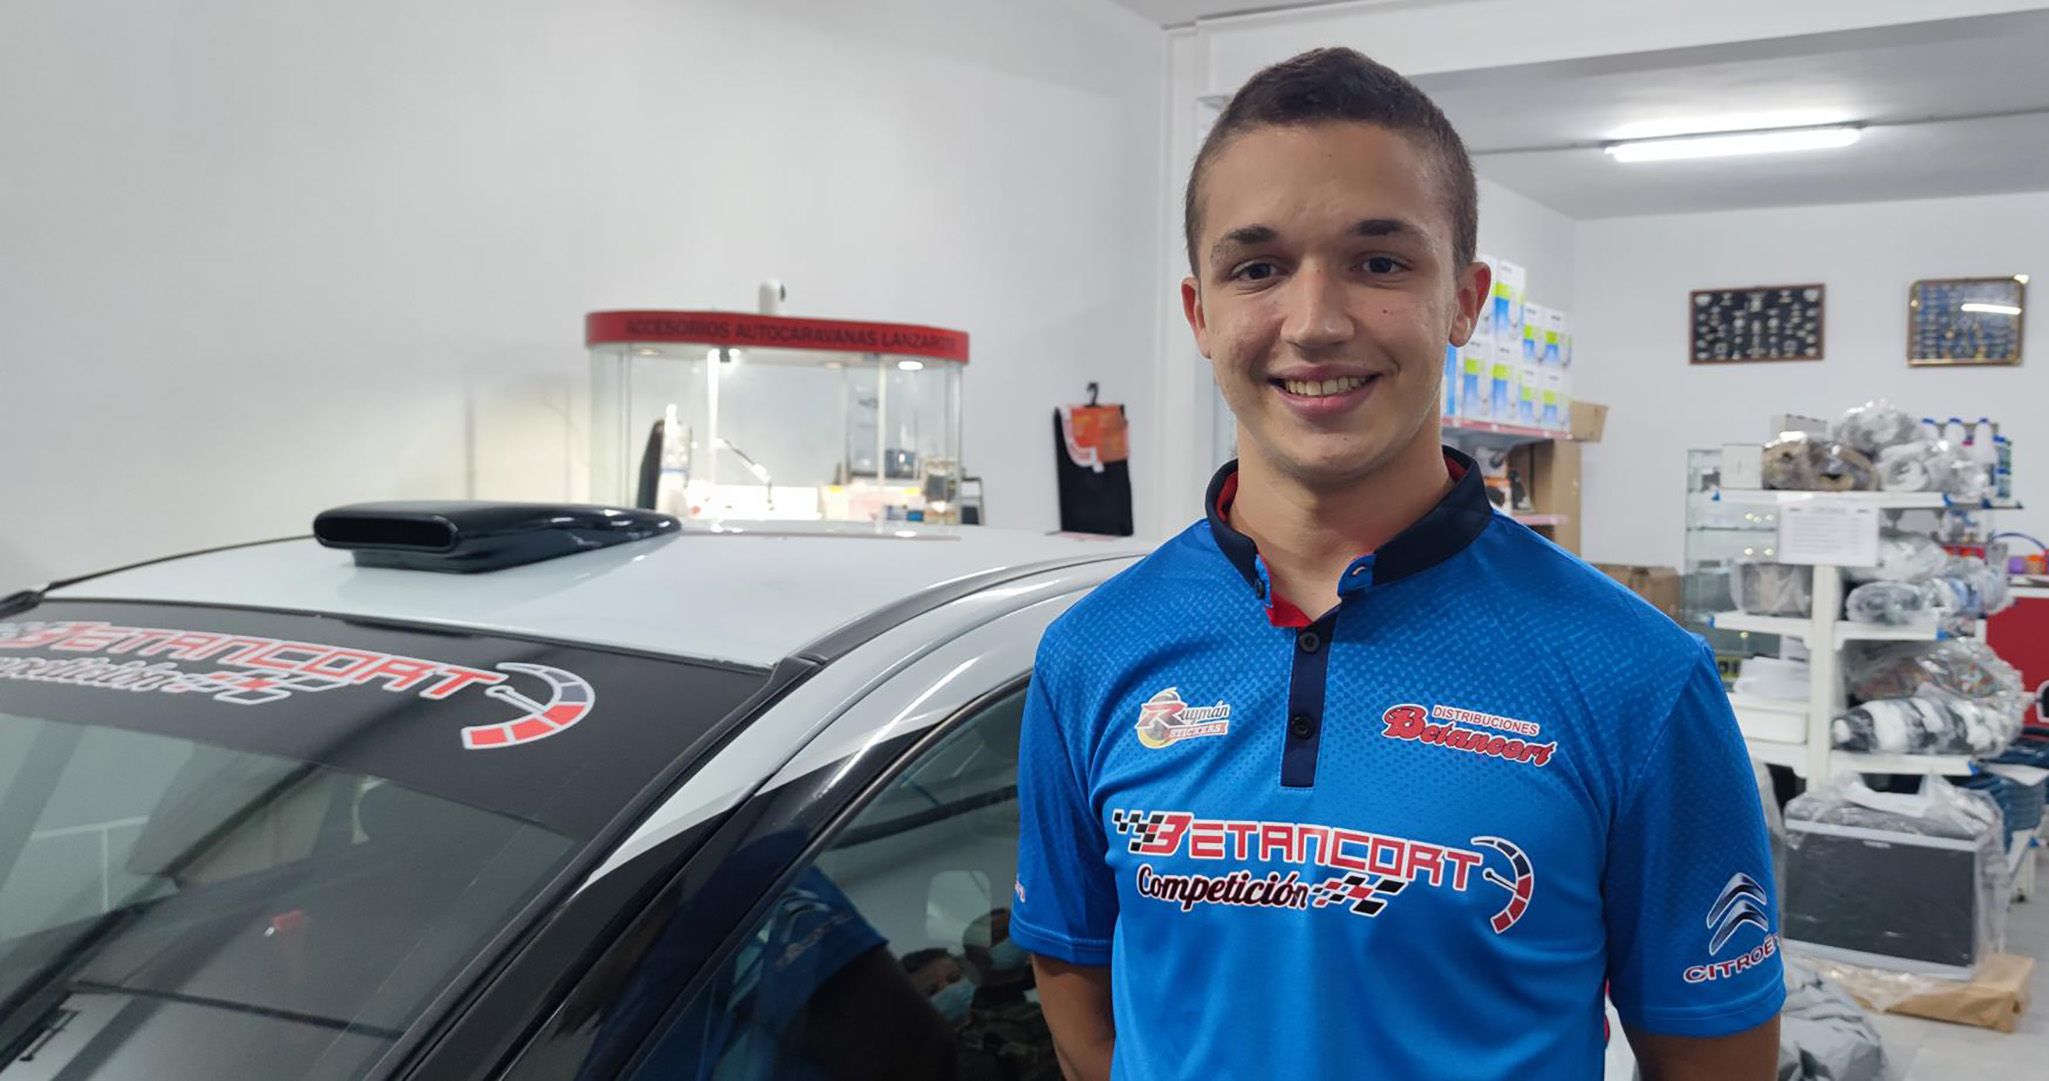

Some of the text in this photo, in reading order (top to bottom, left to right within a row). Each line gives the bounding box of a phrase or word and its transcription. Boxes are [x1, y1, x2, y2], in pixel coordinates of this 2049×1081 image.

[624, 318, 730, 339] ACCESORIOS
[735, 324, 877, 347] AUTOCARAVANAS
[1382, 703, 1557, 766] Betancort
[1431, 704, 1541, 736] DISTRIBUCIONES
[1131, 811, 1483, 891] BETANCORT
[1137, 864, 1309, 912] Competición
